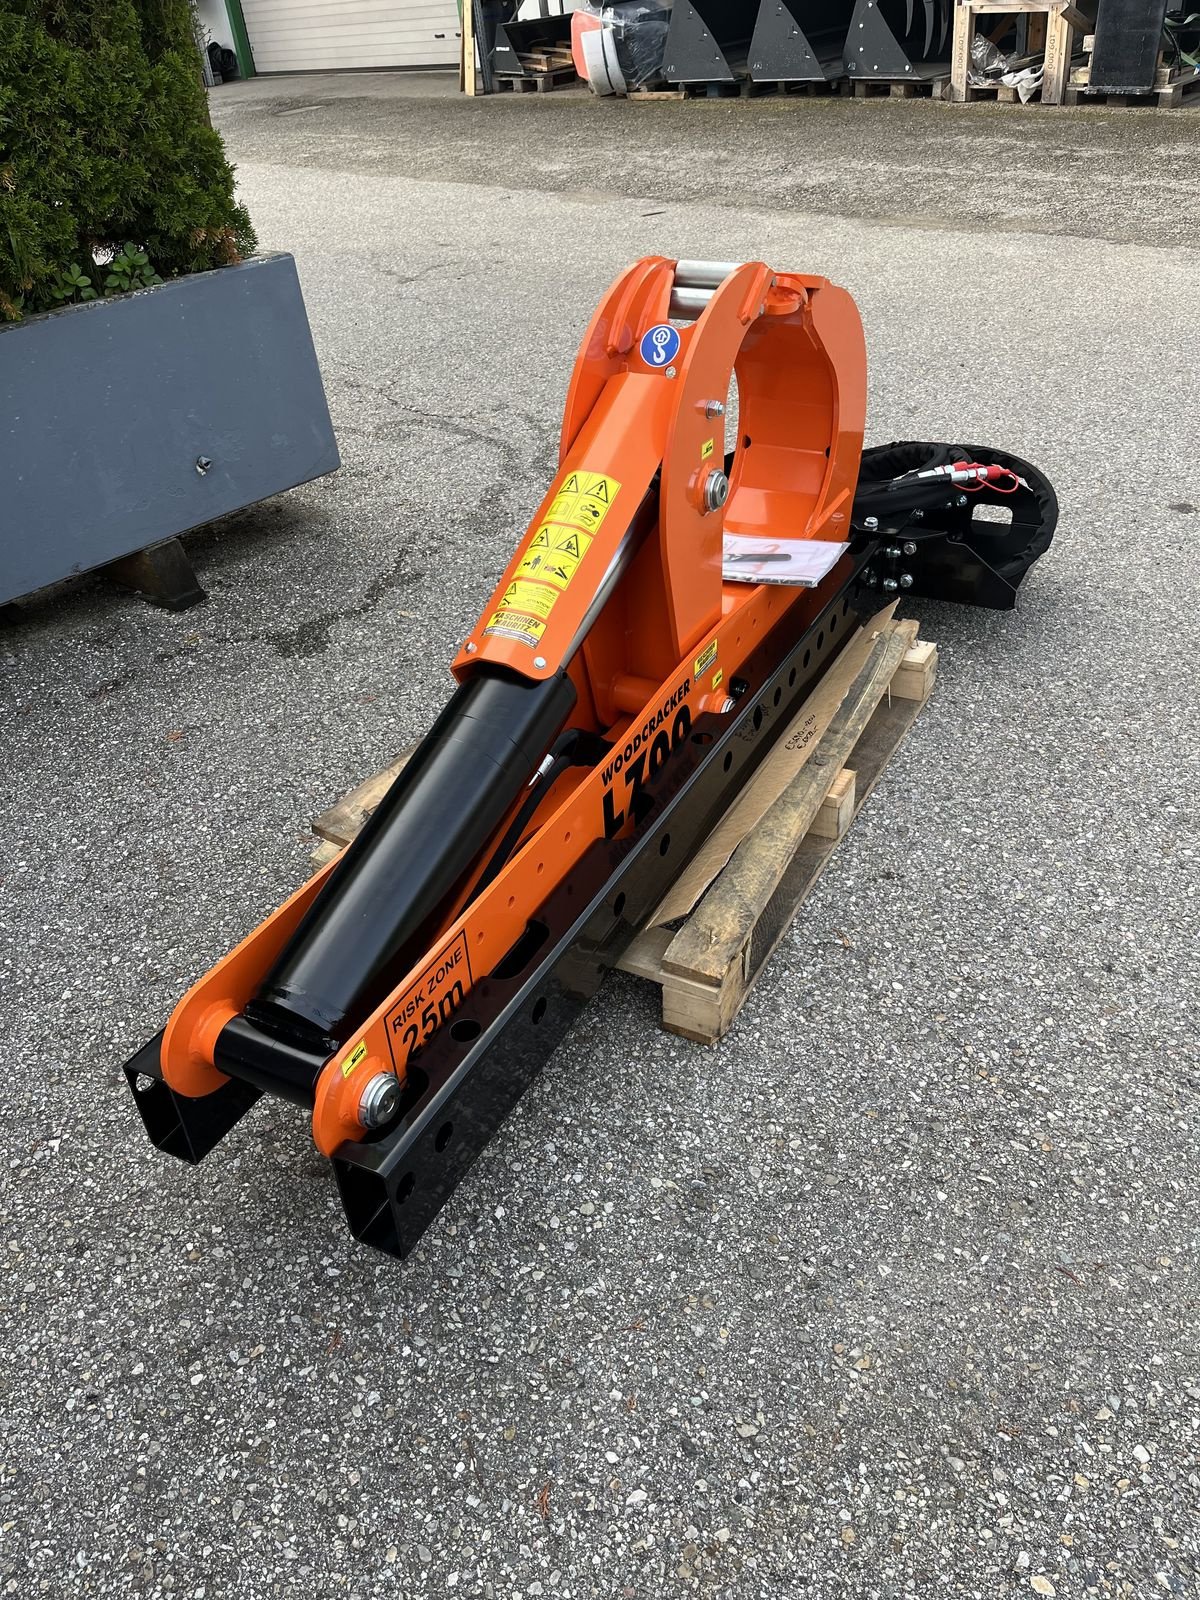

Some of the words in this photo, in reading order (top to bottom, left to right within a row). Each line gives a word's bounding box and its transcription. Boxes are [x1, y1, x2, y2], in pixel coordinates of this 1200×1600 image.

[494, 612, 541, 628] MASCHINEN
[494, 619, 531, 632] MAURITZ
[602, 678, 690, 787] WOODCRACKER
[602, 704, 692, 840] L700
[392, 989, 425, 1034] RISK
[427, 947, 463, 995] ZONE
[402, 979, 465, 1061] 25m
